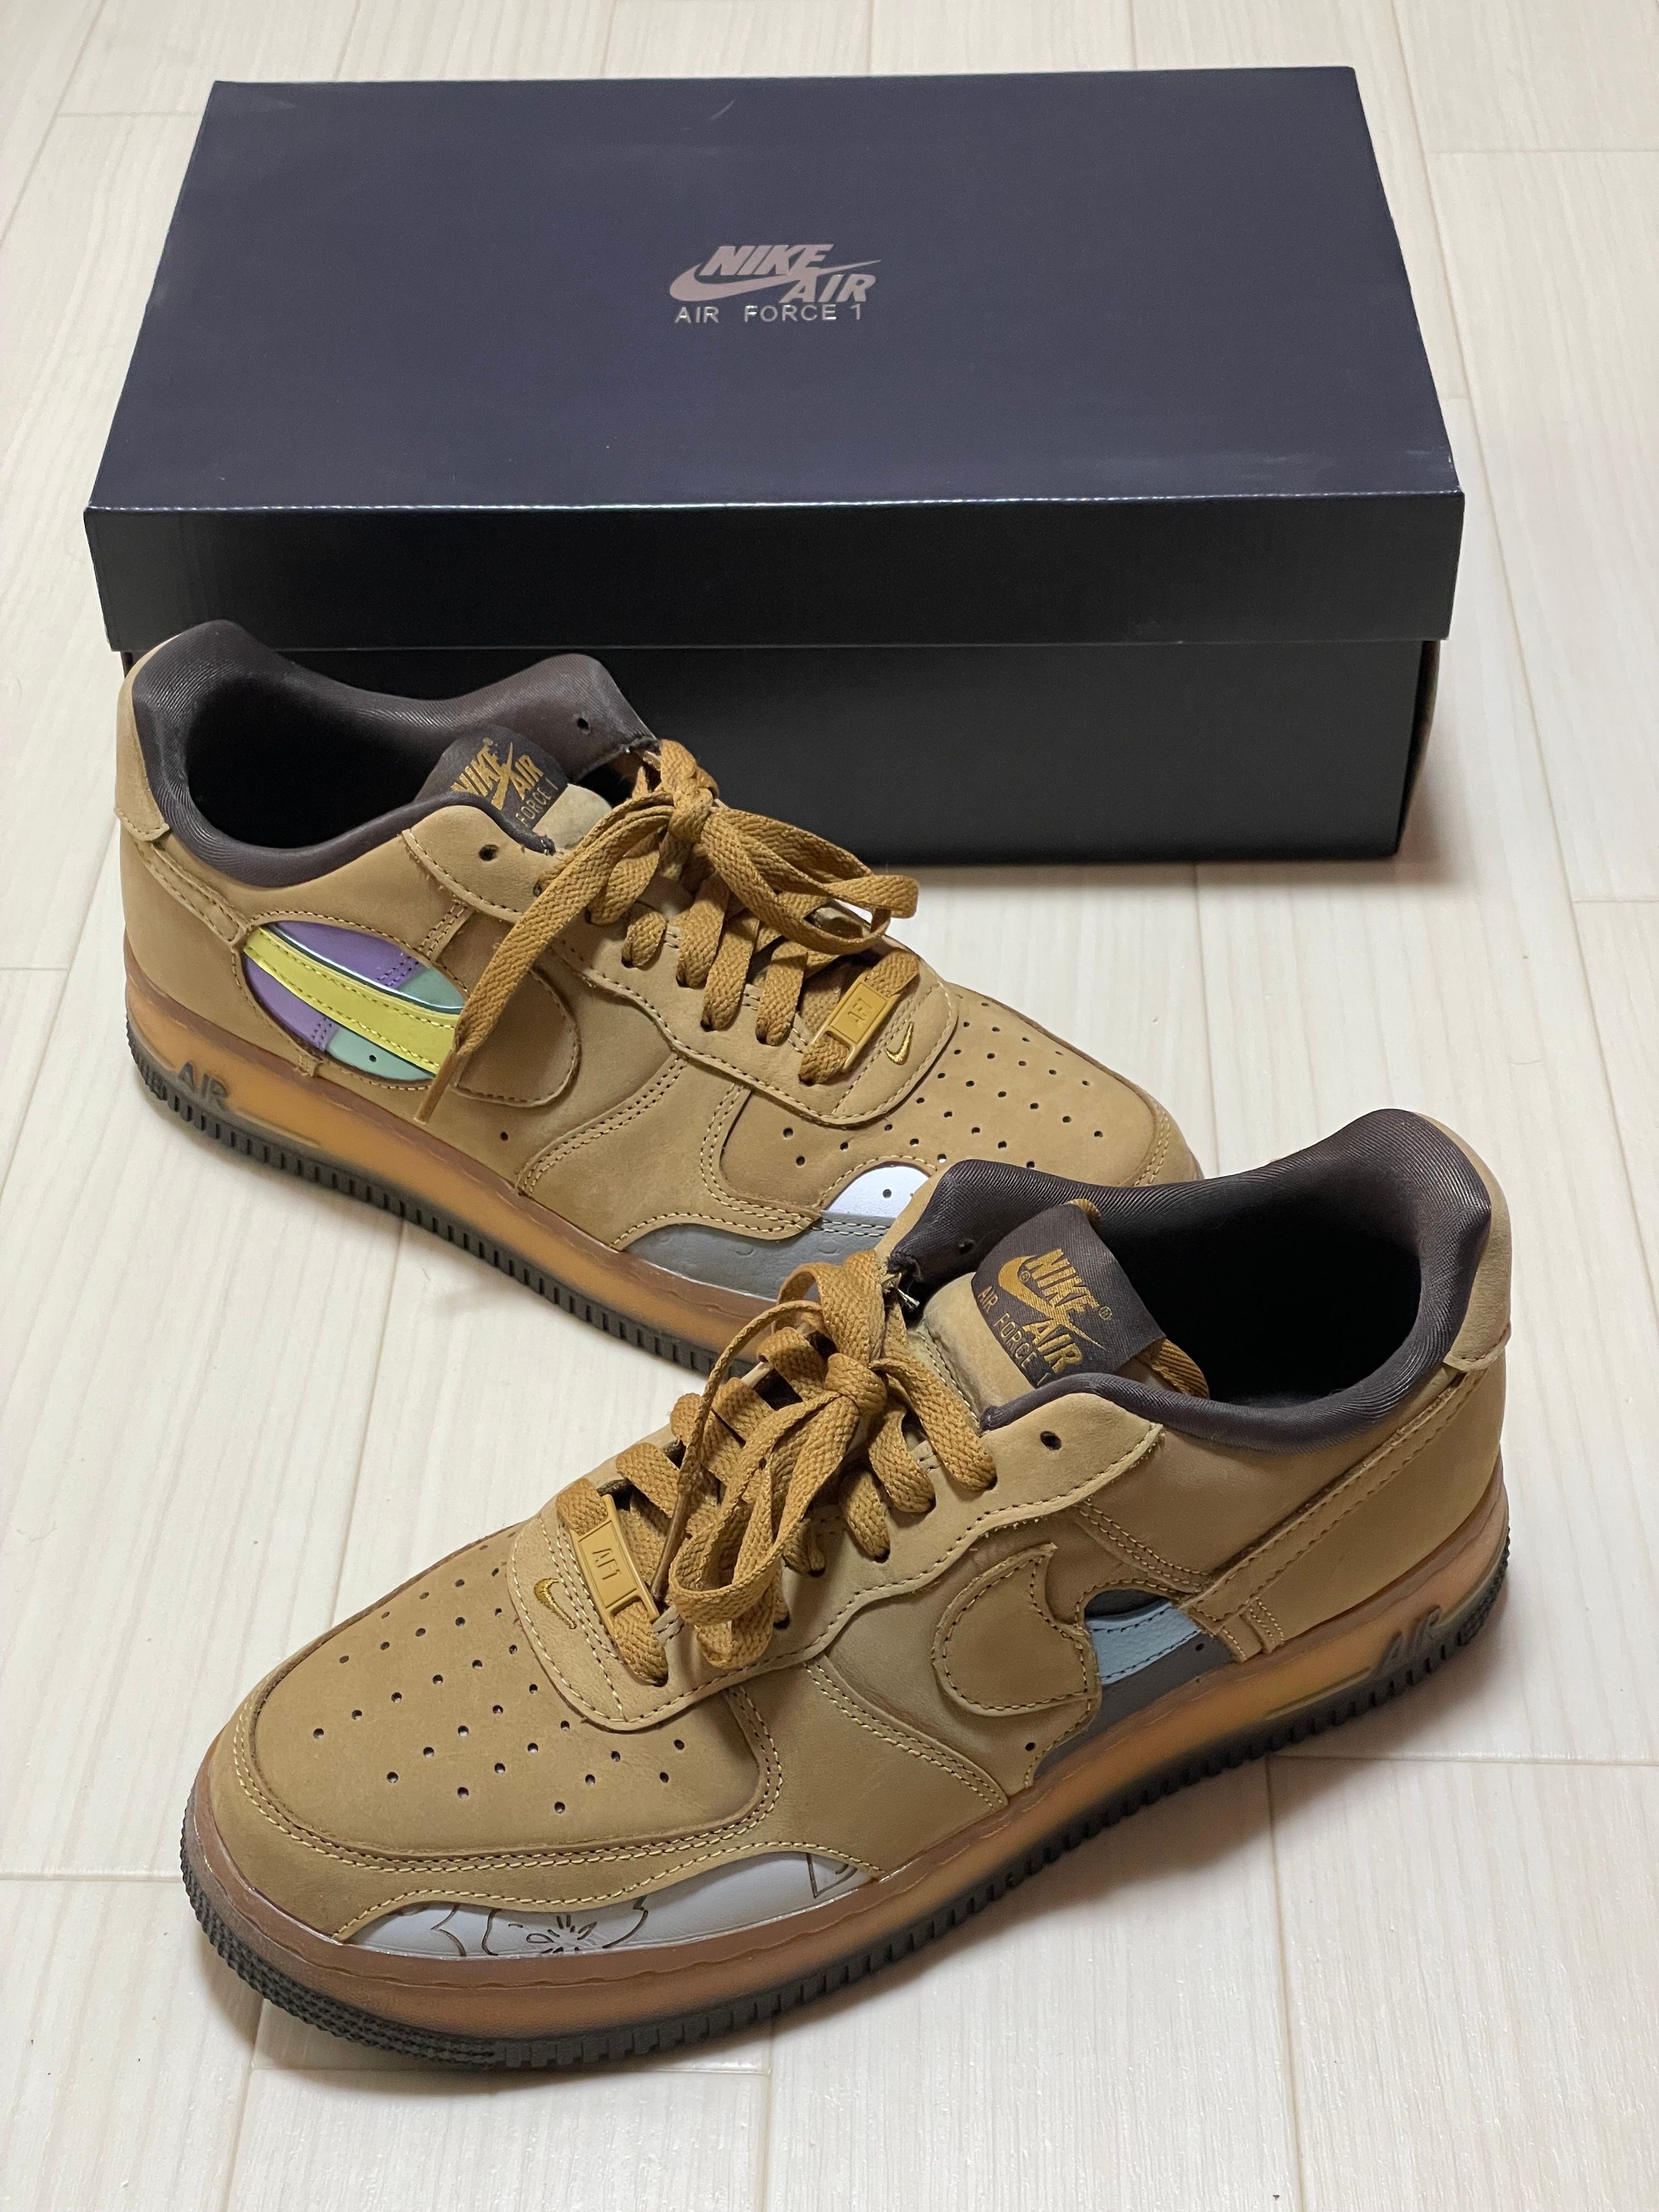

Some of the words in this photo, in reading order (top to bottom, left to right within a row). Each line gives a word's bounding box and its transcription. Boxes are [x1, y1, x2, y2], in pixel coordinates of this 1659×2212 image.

[698, 244, 834, 275] NIKE
[779, 274, 877, 303] AIR
[674, 306, 720, 324] AIR
[743, 303, 837, 324] FORCE
[850, 303, 861, 320] 1
[450, 744, 504, 797] NIKE
[509, 754, 544, 801] AIR
[515, 787, 552, 828] FORCE
[1024, 1248, 1099, 1314] NIKE
[977, 1285, 999, 1313] AIR
[994, 1312, 1039, 1370] FORCE
[1022, 1318, 1084, 1373] AIR
